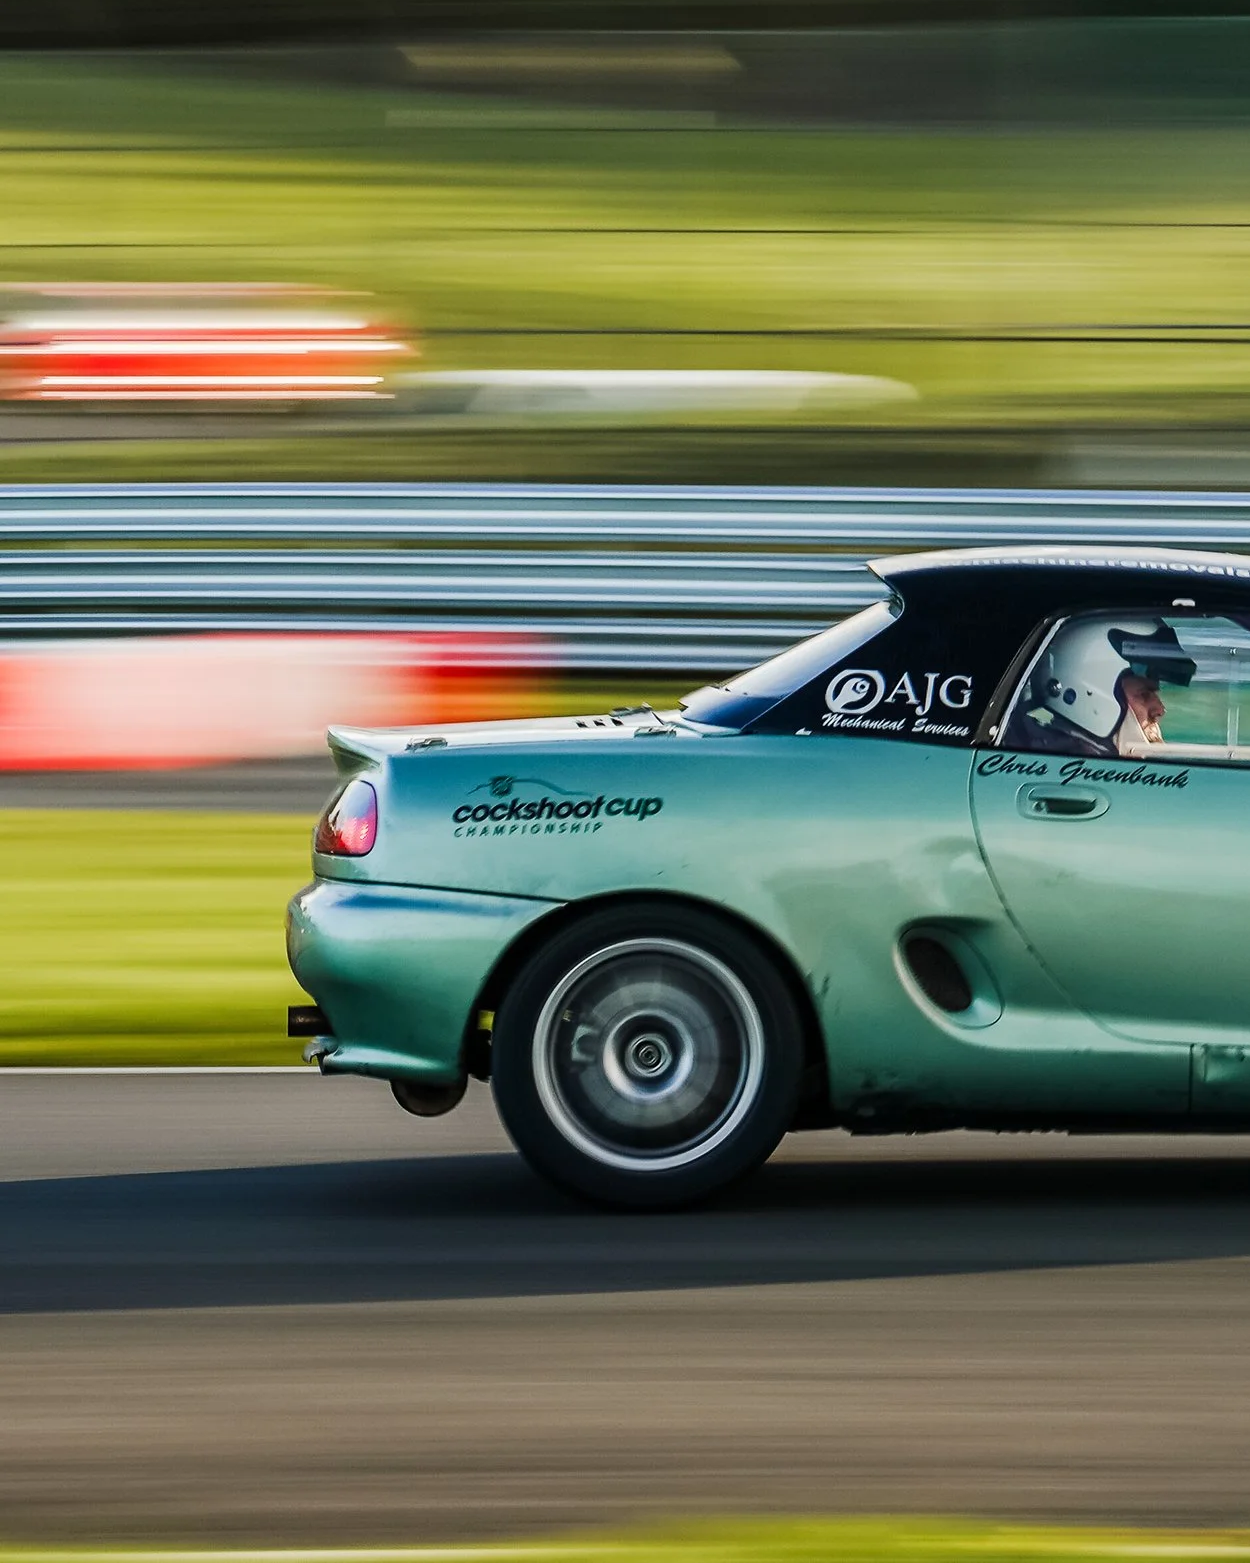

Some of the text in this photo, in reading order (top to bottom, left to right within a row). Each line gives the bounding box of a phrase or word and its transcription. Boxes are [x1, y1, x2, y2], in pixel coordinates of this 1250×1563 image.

[884, 671, 973, 716] AJG
[822, 712, 970, 736] Mechanical Services
[977, 754, 1189, 788] Chris Greenbank
[454, 822, 603, 837] CHAMPIONSHIP
